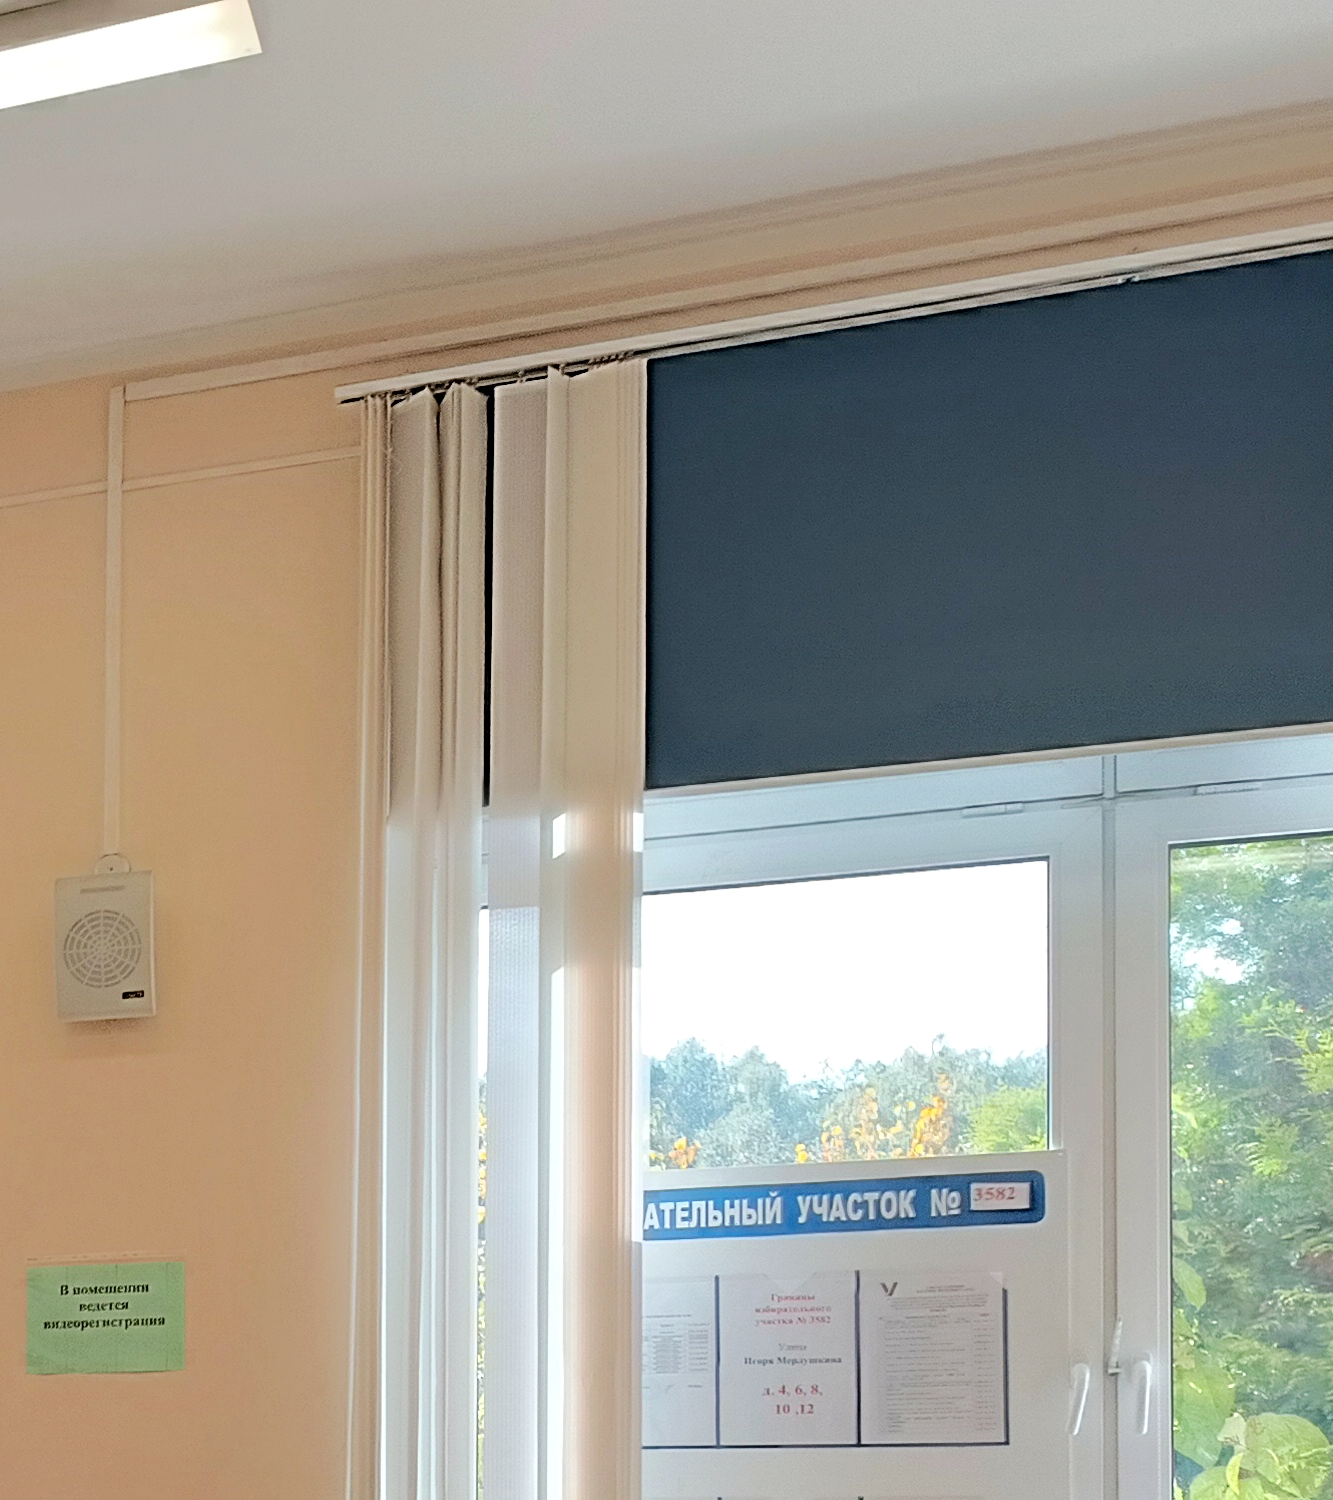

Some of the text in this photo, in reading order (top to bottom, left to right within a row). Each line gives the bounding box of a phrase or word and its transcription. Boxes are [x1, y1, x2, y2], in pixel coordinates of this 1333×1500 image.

[643, 1186, 1016, 1230] АТЕЛЬНЫЙ УЧАСТОК № 3582
[60, 1284, 69, 1296] В
[79, 1300, 129, 1312] ведется
[43, 1316, 166, 1331] видеорегистрация
[775, 1403, 791, 1415] 10
